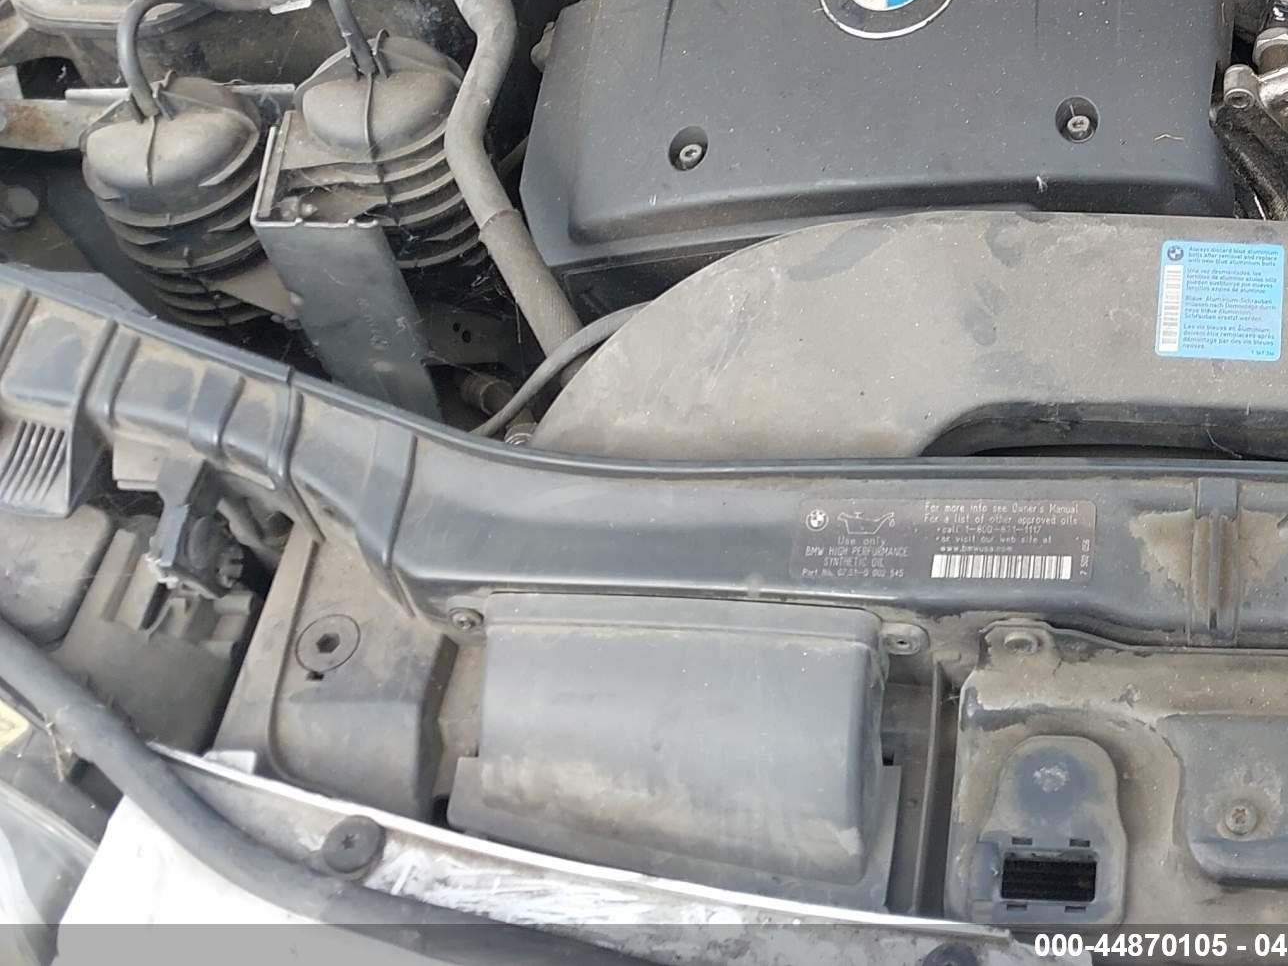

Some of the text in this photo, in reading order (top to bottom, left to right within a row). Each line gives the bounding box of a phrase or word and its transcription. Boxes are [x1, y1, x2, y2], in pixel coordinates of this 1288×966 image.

[805, 546, 910, 557] BMW HIGH PERFORMANCE
